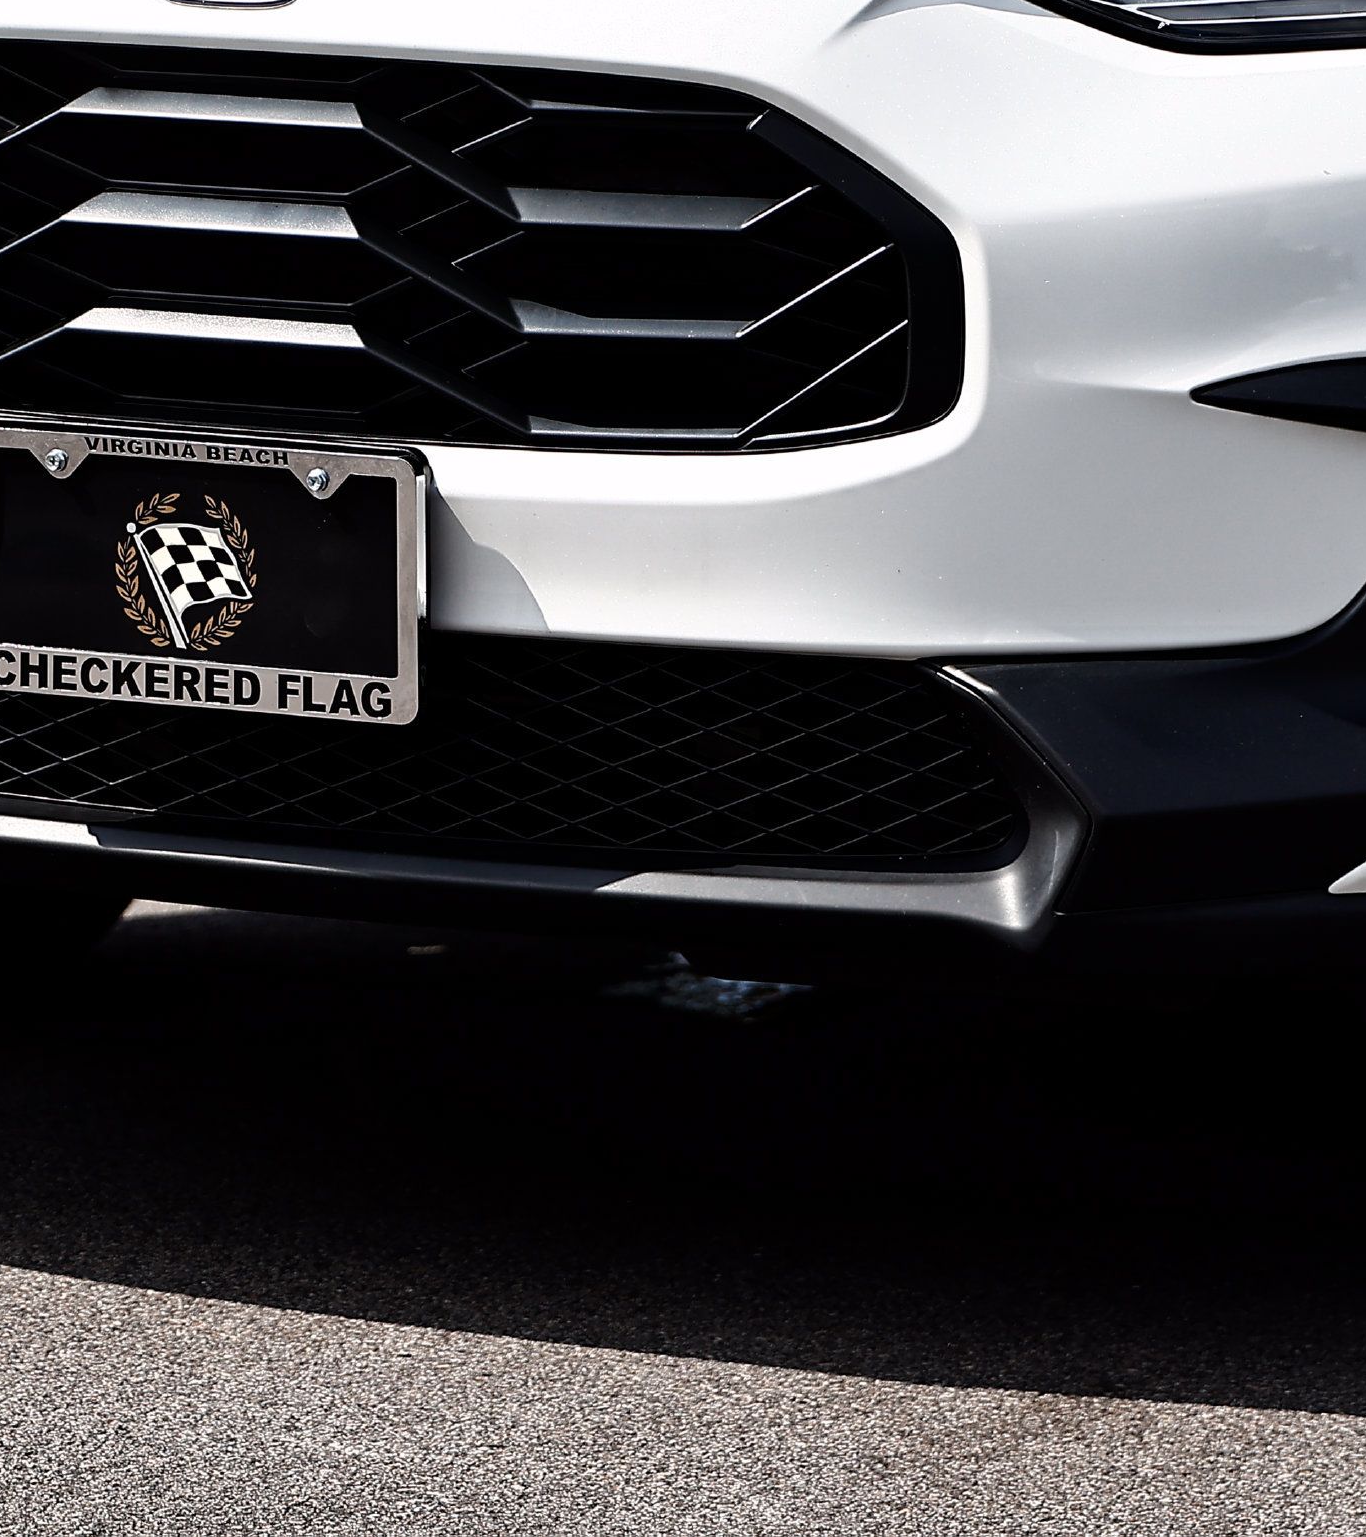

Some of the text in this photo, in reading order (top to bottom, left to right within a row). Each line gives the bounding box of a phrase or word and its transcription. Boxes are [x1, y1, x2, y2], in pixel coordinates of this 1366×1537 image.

[84, 436, 290, 467] VIRGINIA BEACH
[277, 674, 392, 719] FLAG
